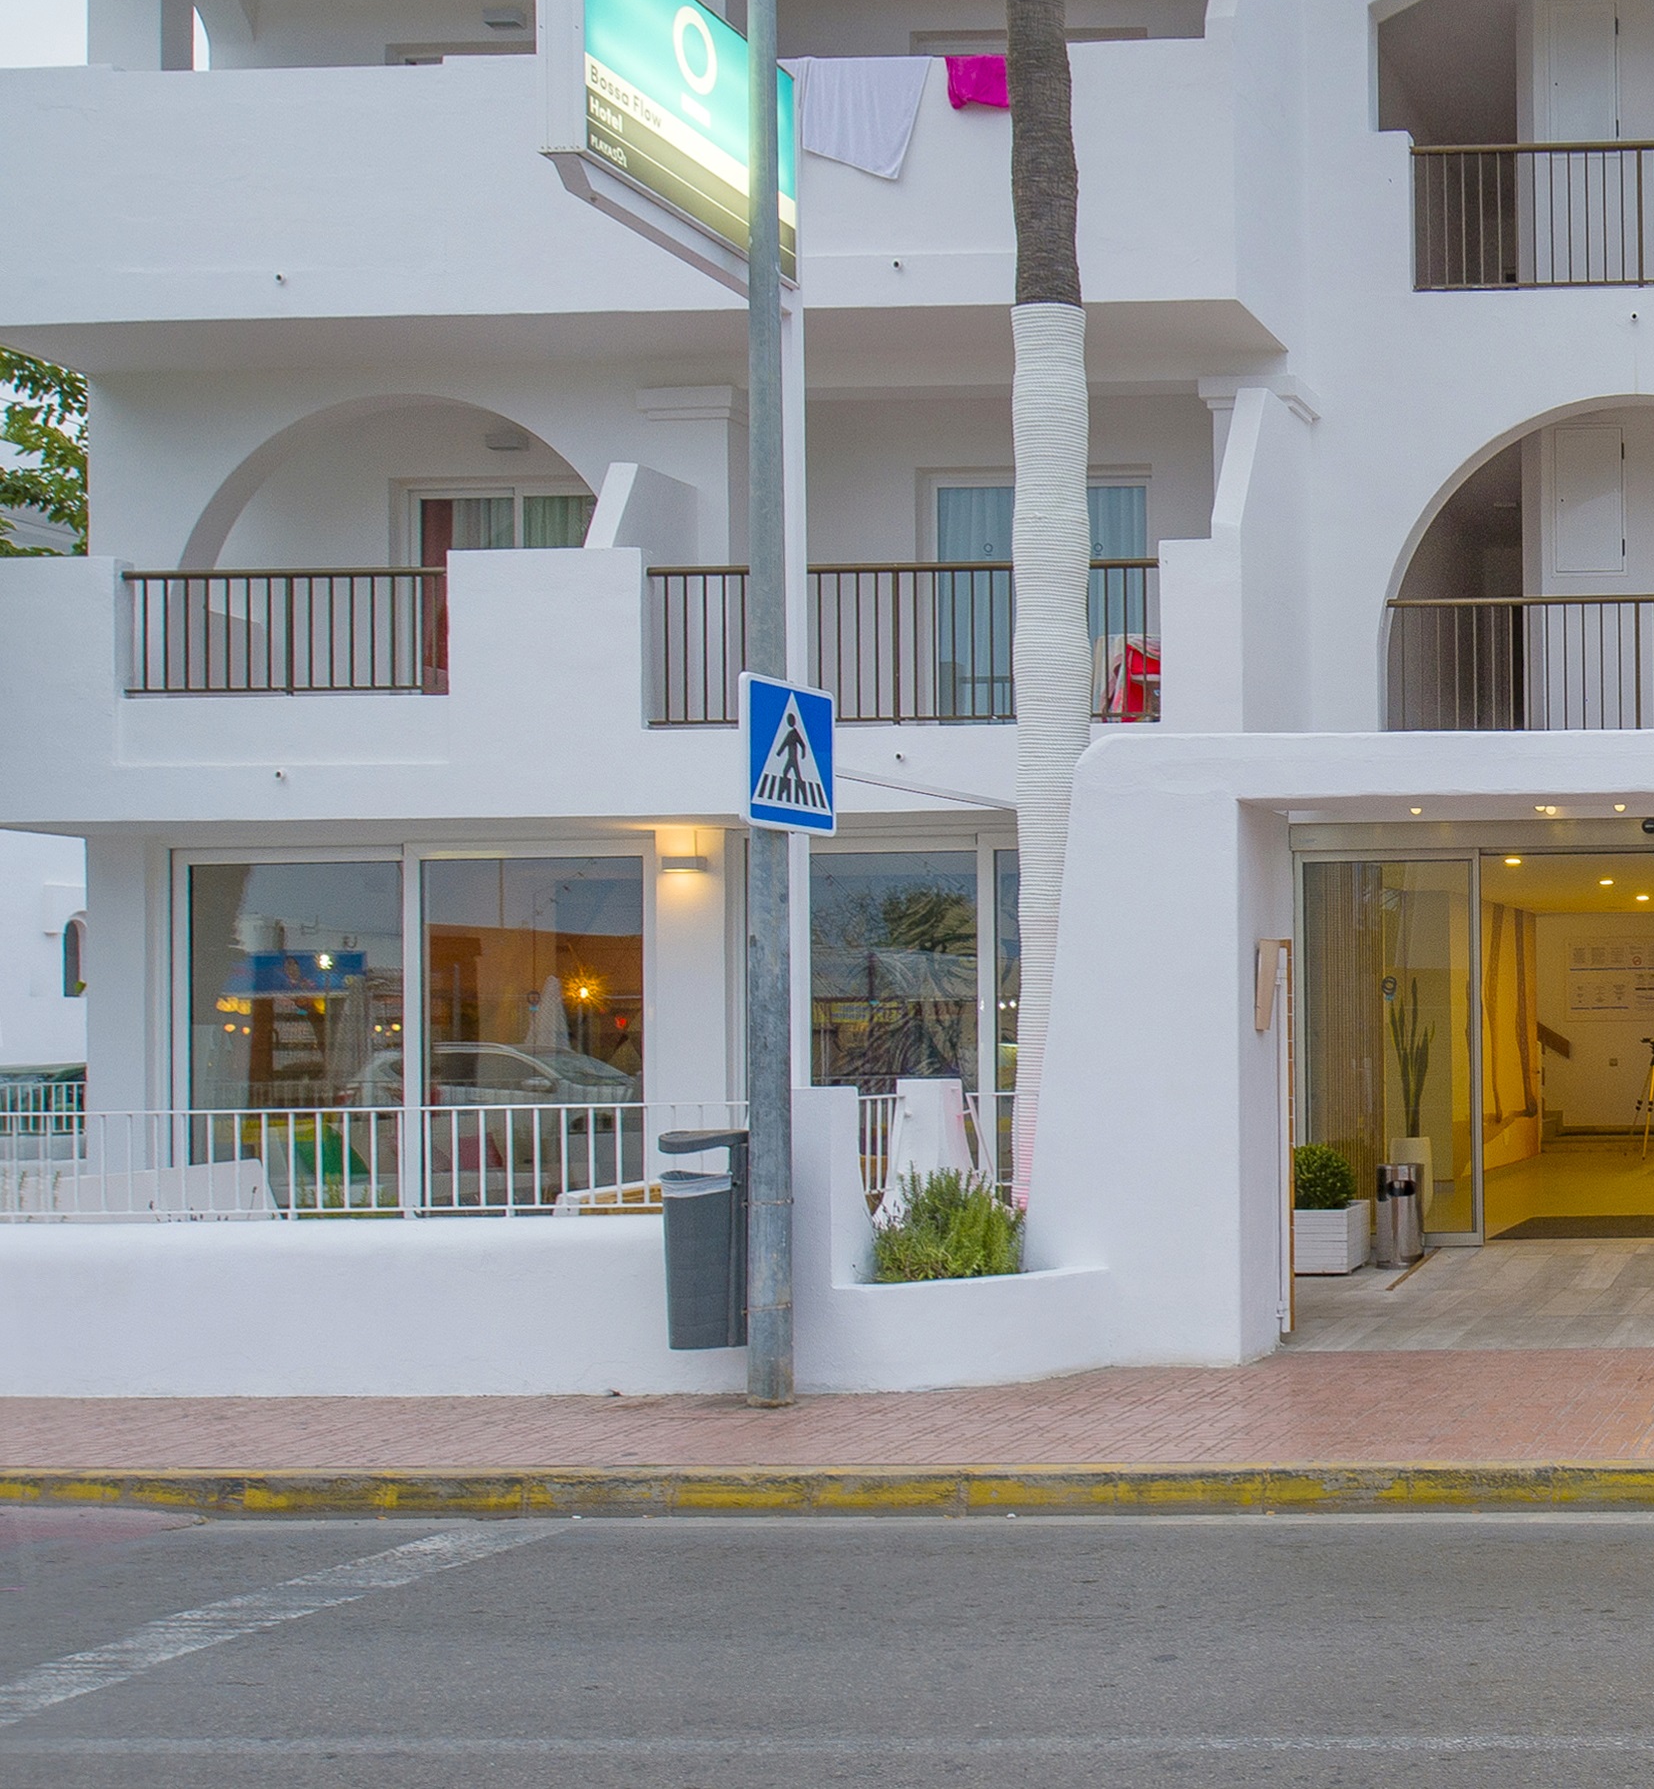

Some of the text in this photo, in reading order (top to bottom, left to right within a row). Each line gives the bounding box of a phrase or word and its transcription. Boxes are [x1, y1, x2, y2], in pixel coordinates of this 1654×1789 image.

[590, 64, 662, 128] Bossa Flow
[590, 95, 623, 134] Hotel
